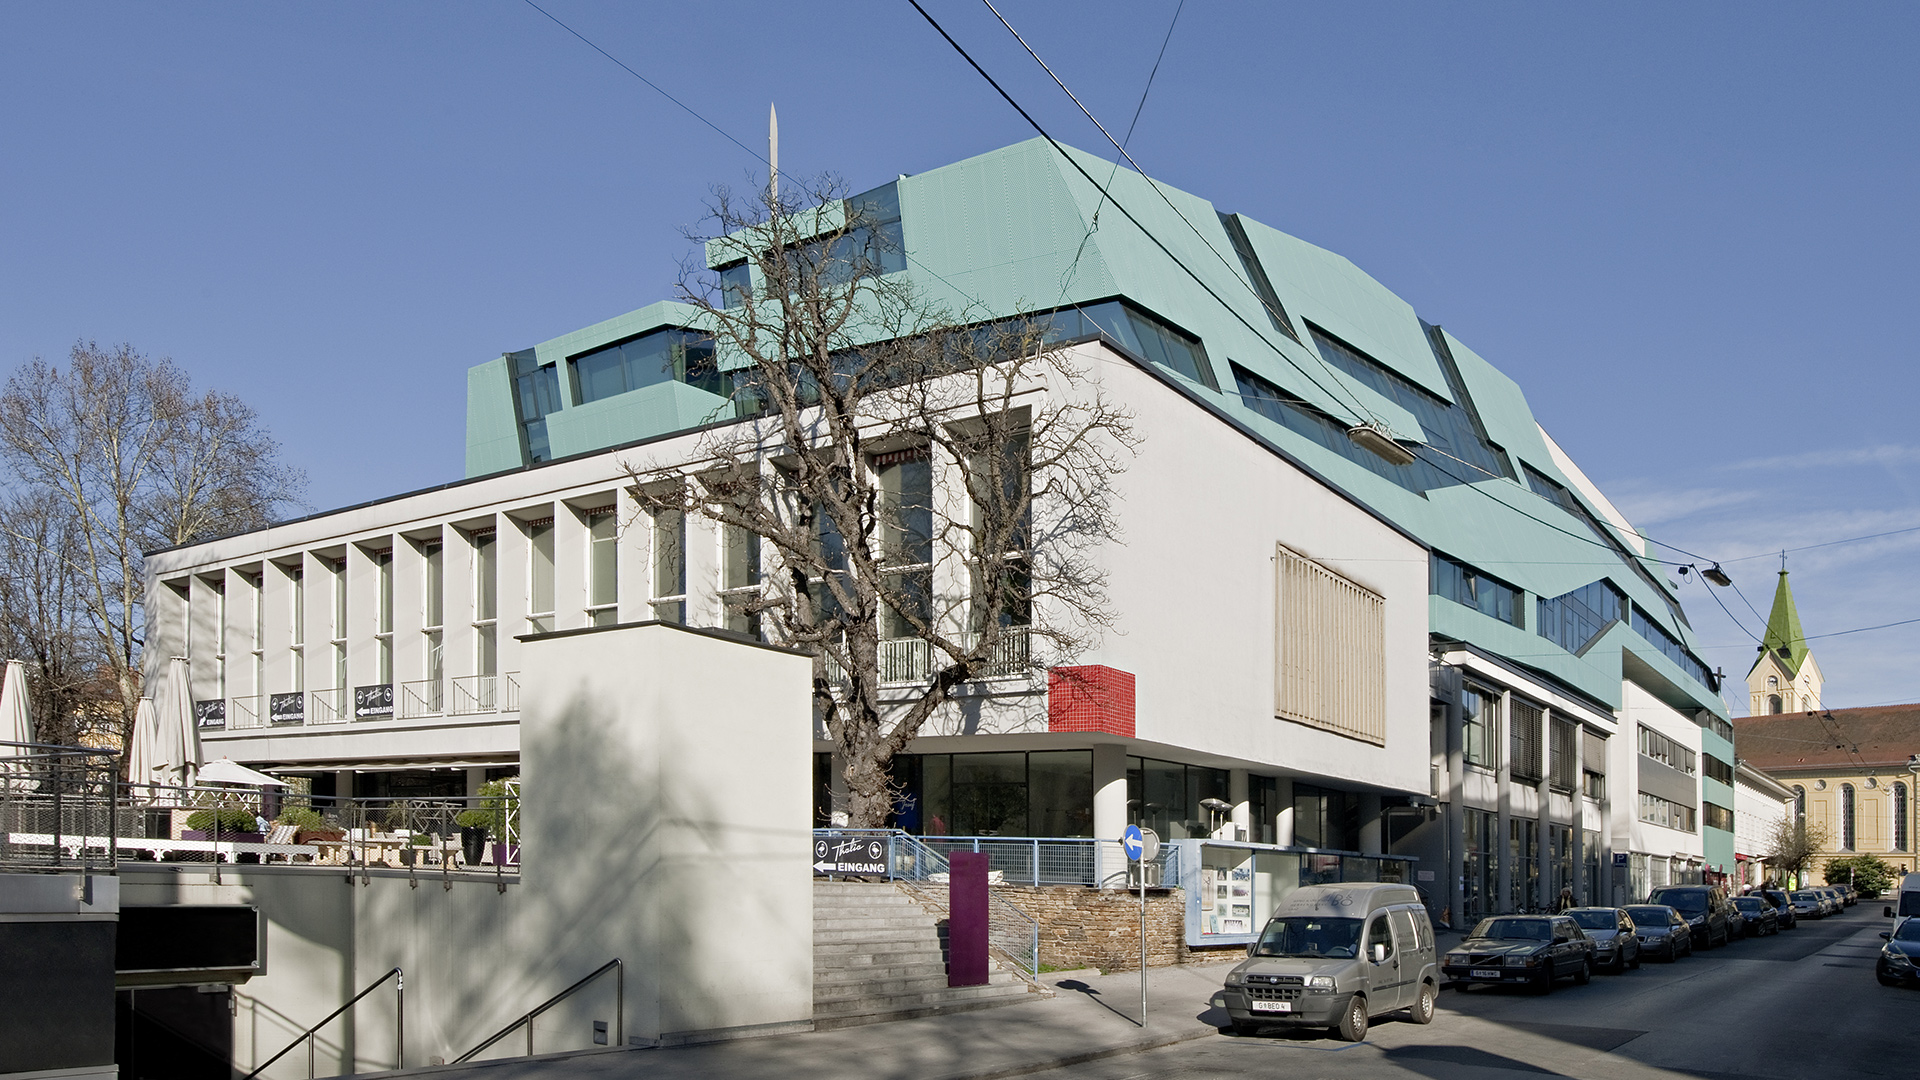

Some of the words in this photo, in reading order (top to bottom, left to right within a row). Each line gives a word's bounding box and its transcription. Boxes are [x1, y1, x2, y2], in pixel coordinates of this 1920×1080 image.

[371, 706, 394, 715] EINGANG
[282, 712, 304, 721] EINGANG
[206, 718, 225, 726] EINGANG
[831, 838, 865, 862] Thalia
[1617, 855, 1624, 863] P
[837, 862, 885, 873] EINGANG
